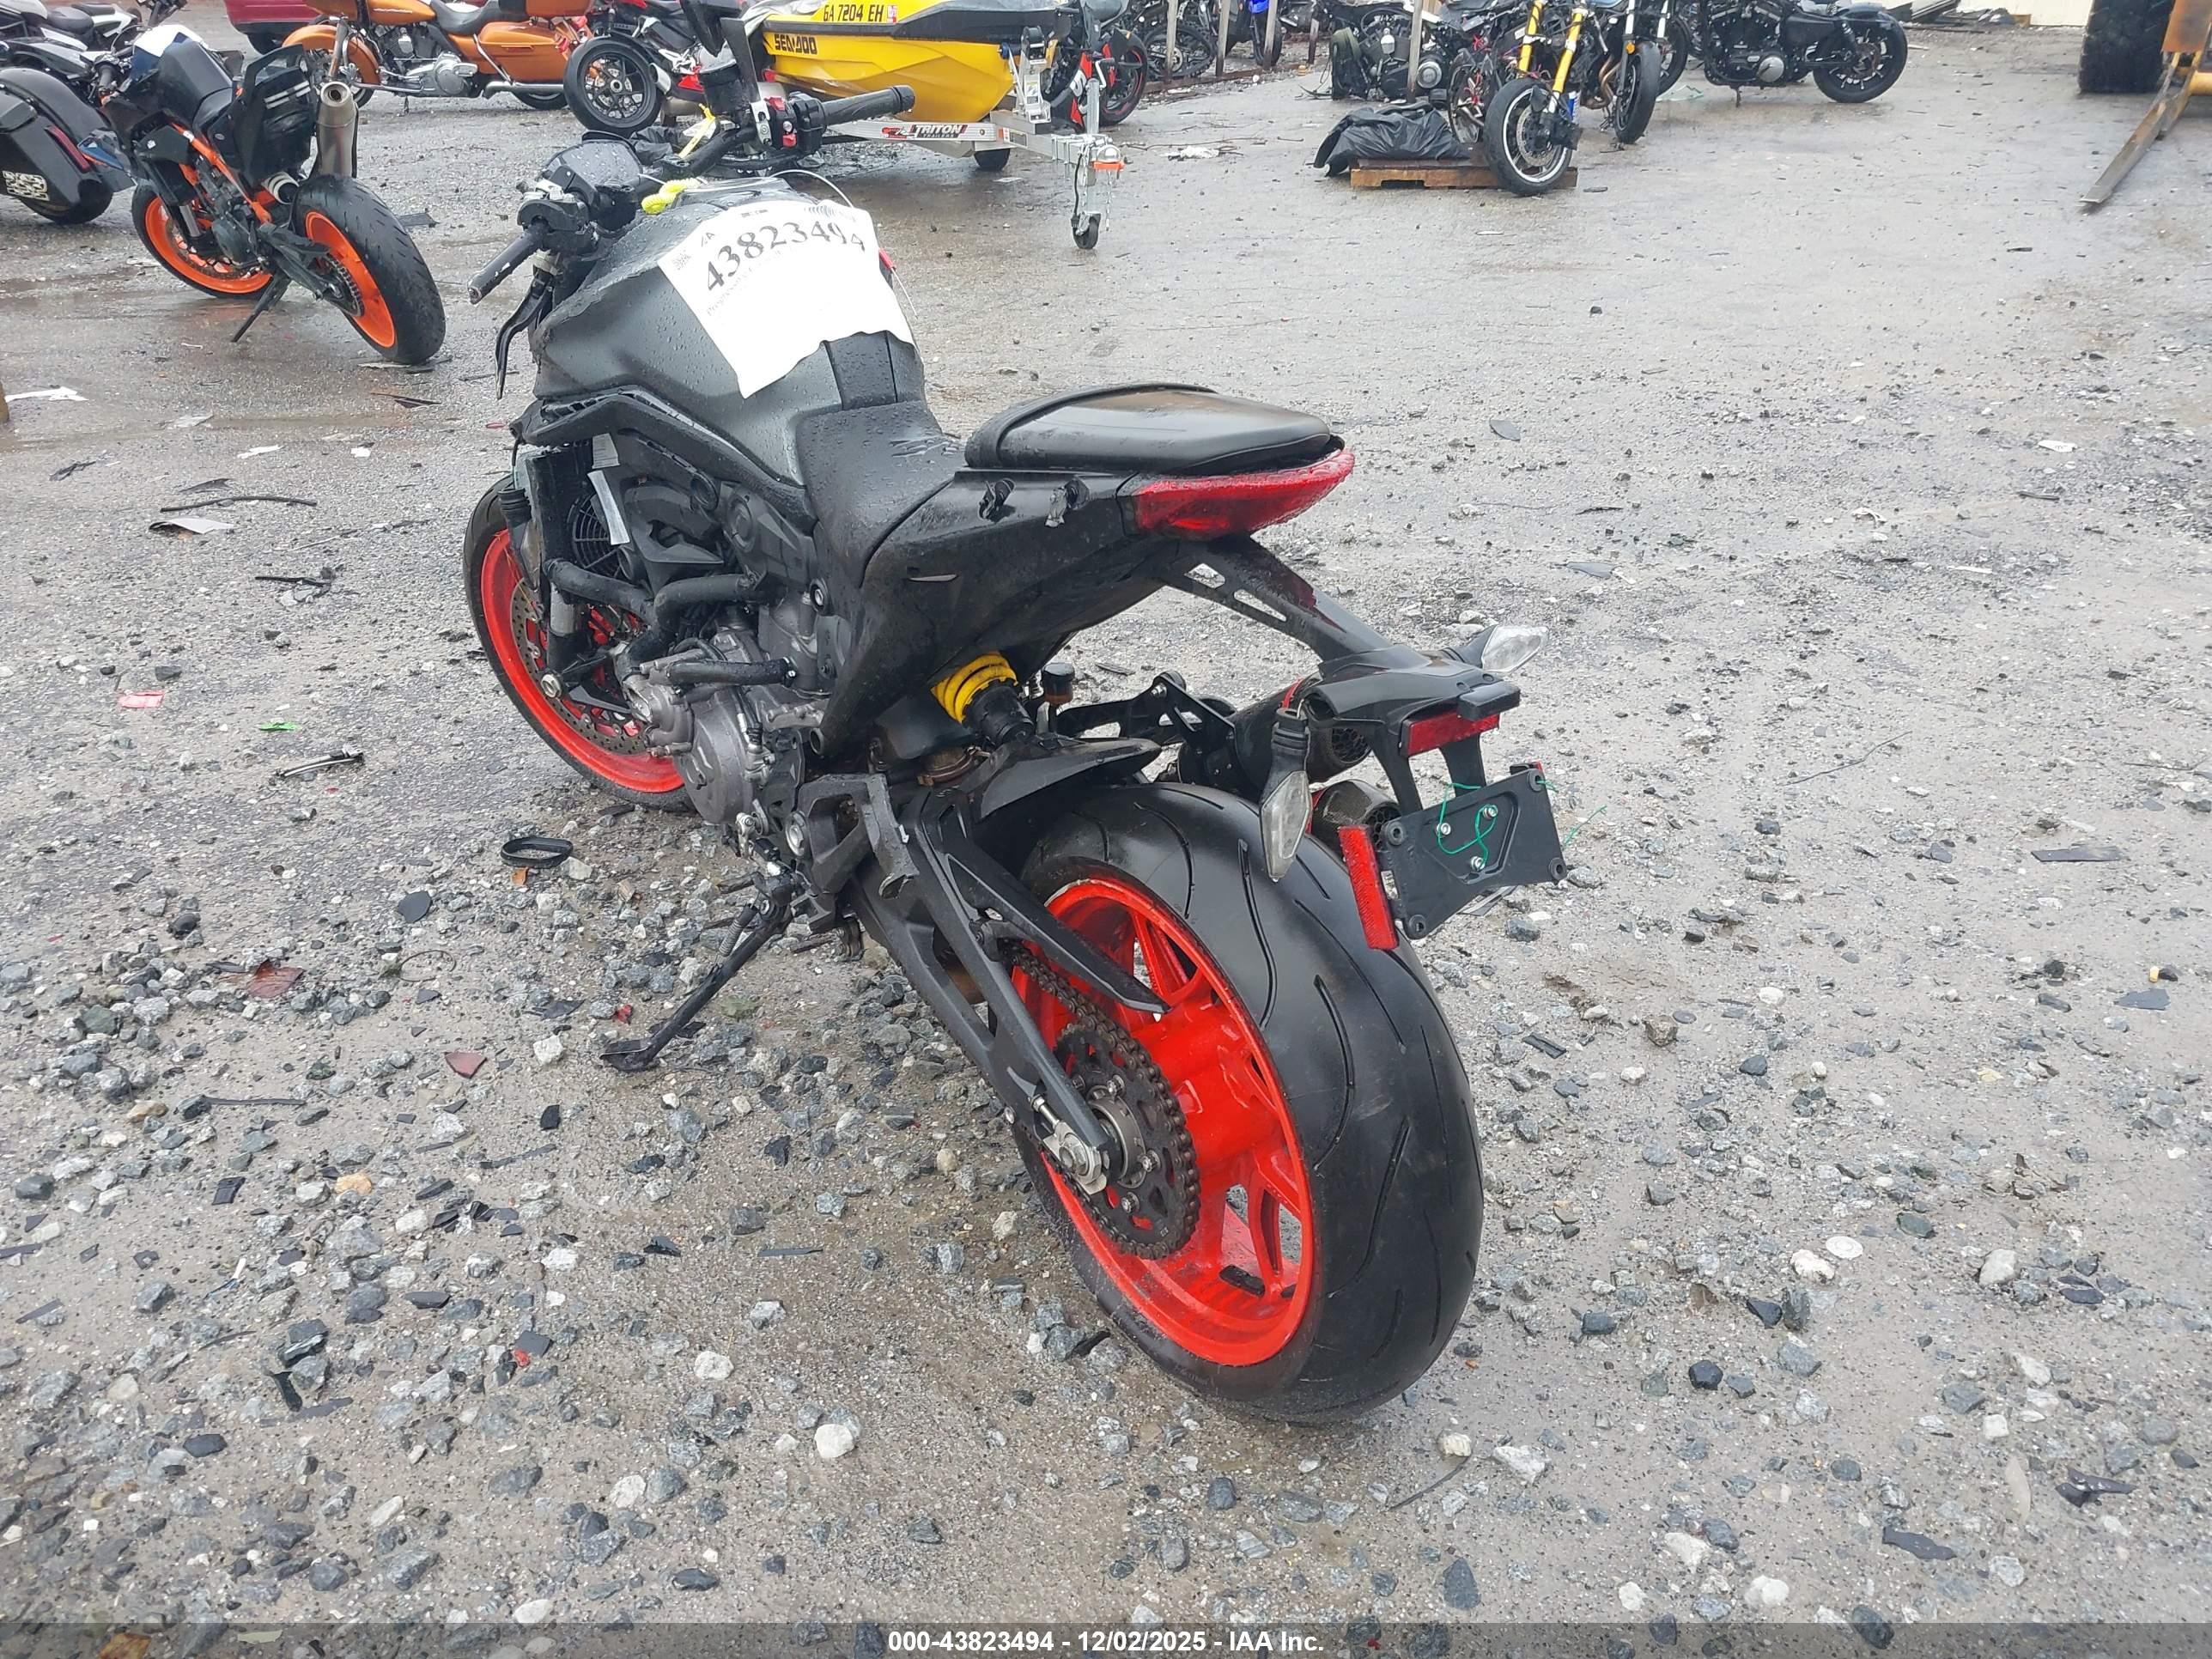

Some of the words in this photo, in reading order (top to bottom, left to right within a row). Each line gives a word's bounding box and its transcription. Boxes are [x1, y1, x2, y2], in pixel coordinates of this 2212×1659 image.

[837, 4, 864, 22] 7204
[868, 5, 884, 22] EH
[915, 125, 963, 135] TRITON
[708, 221, 866, 290] 43823494
